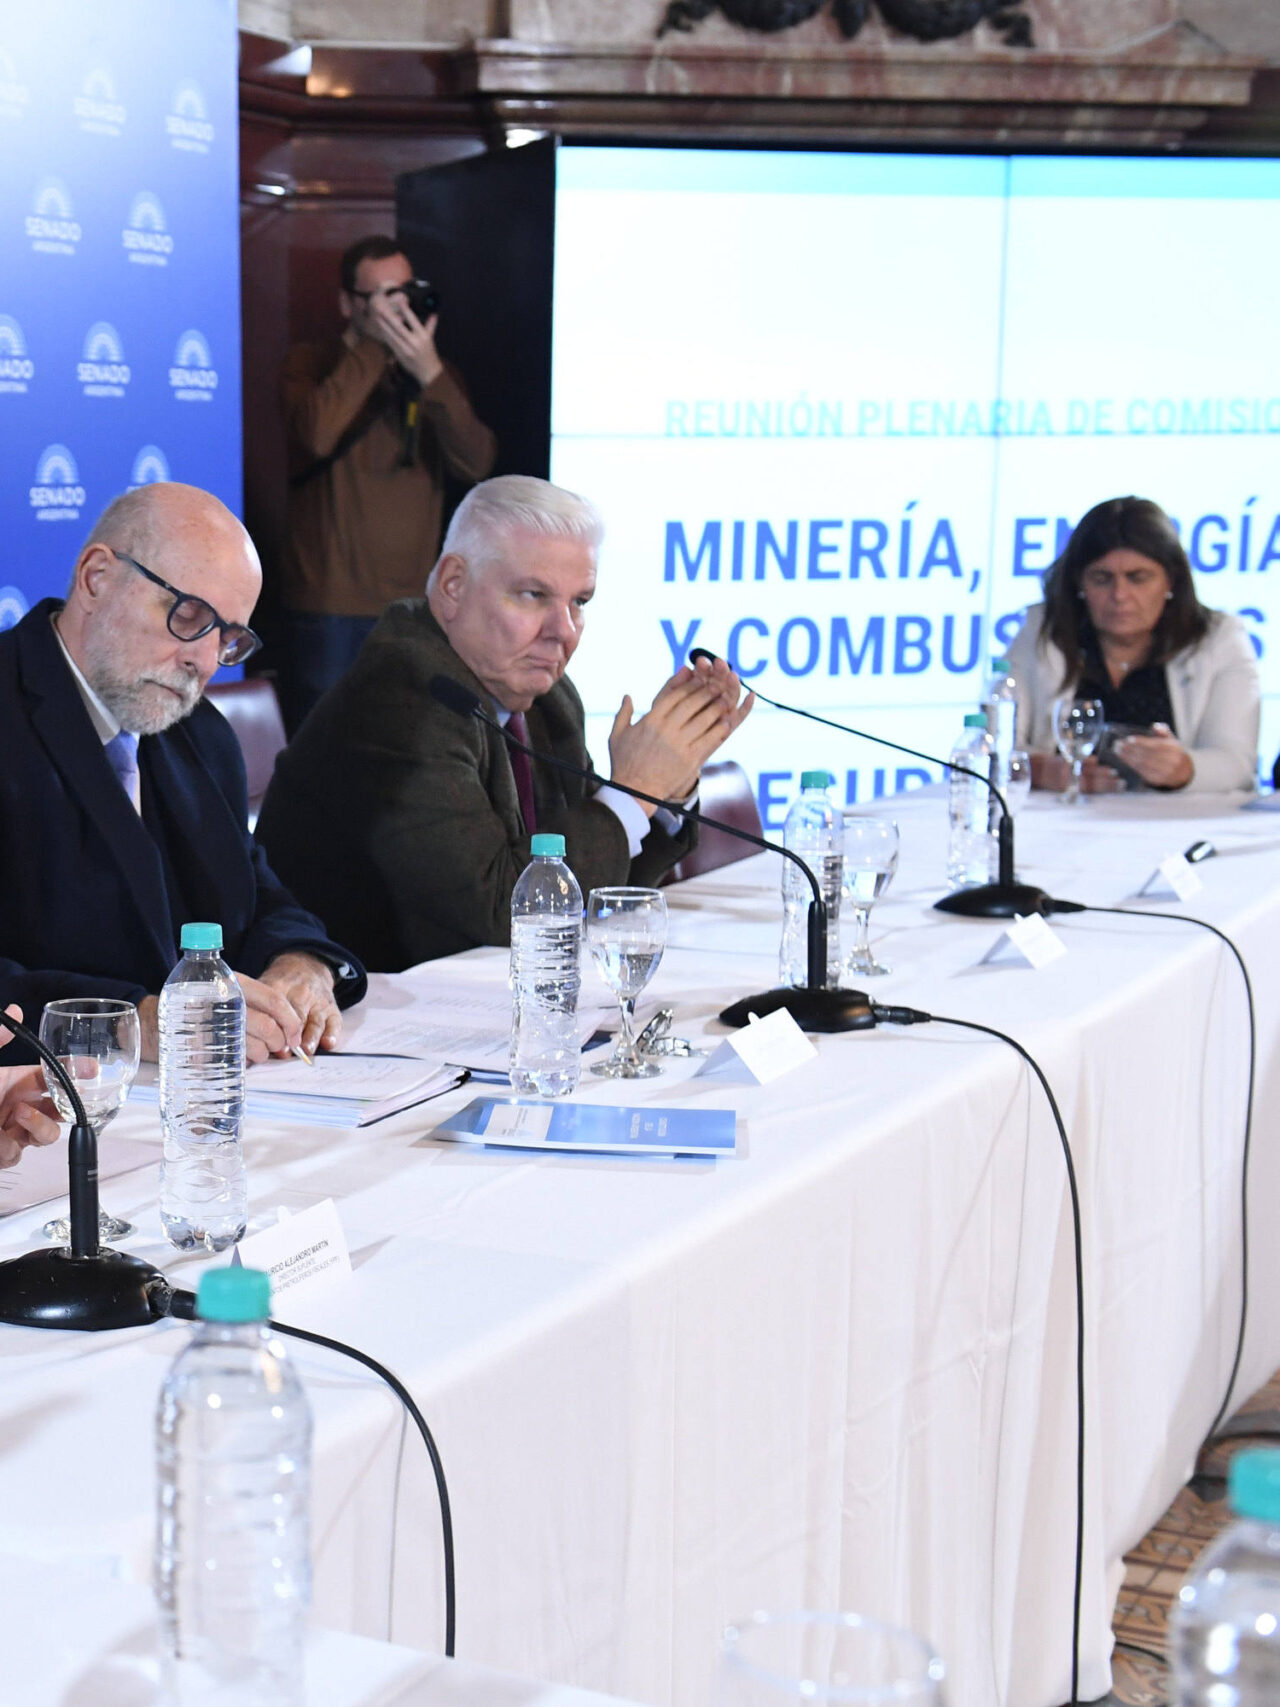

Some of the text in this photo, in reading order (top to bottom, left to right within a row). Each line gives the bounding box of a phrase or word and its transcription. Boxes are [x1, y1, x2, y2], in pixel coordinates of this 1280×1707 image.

[25, 216, 81, 242] SENADO
[122, 230, 174, 254] SENADO
[77, 363, 131, 385] SENADO
[168, 368, 218, 389] SENADO
[664, 390, 843, 437] REUNIÓN
[857, 398, 1050, 437] PLENARIA
[1068, 398, 1115, 436] DE
[29, 486, 85, 507] SENADO
[663, 499, 981, 593] MINERÍA,
[659, 617, 702, 676] Y
